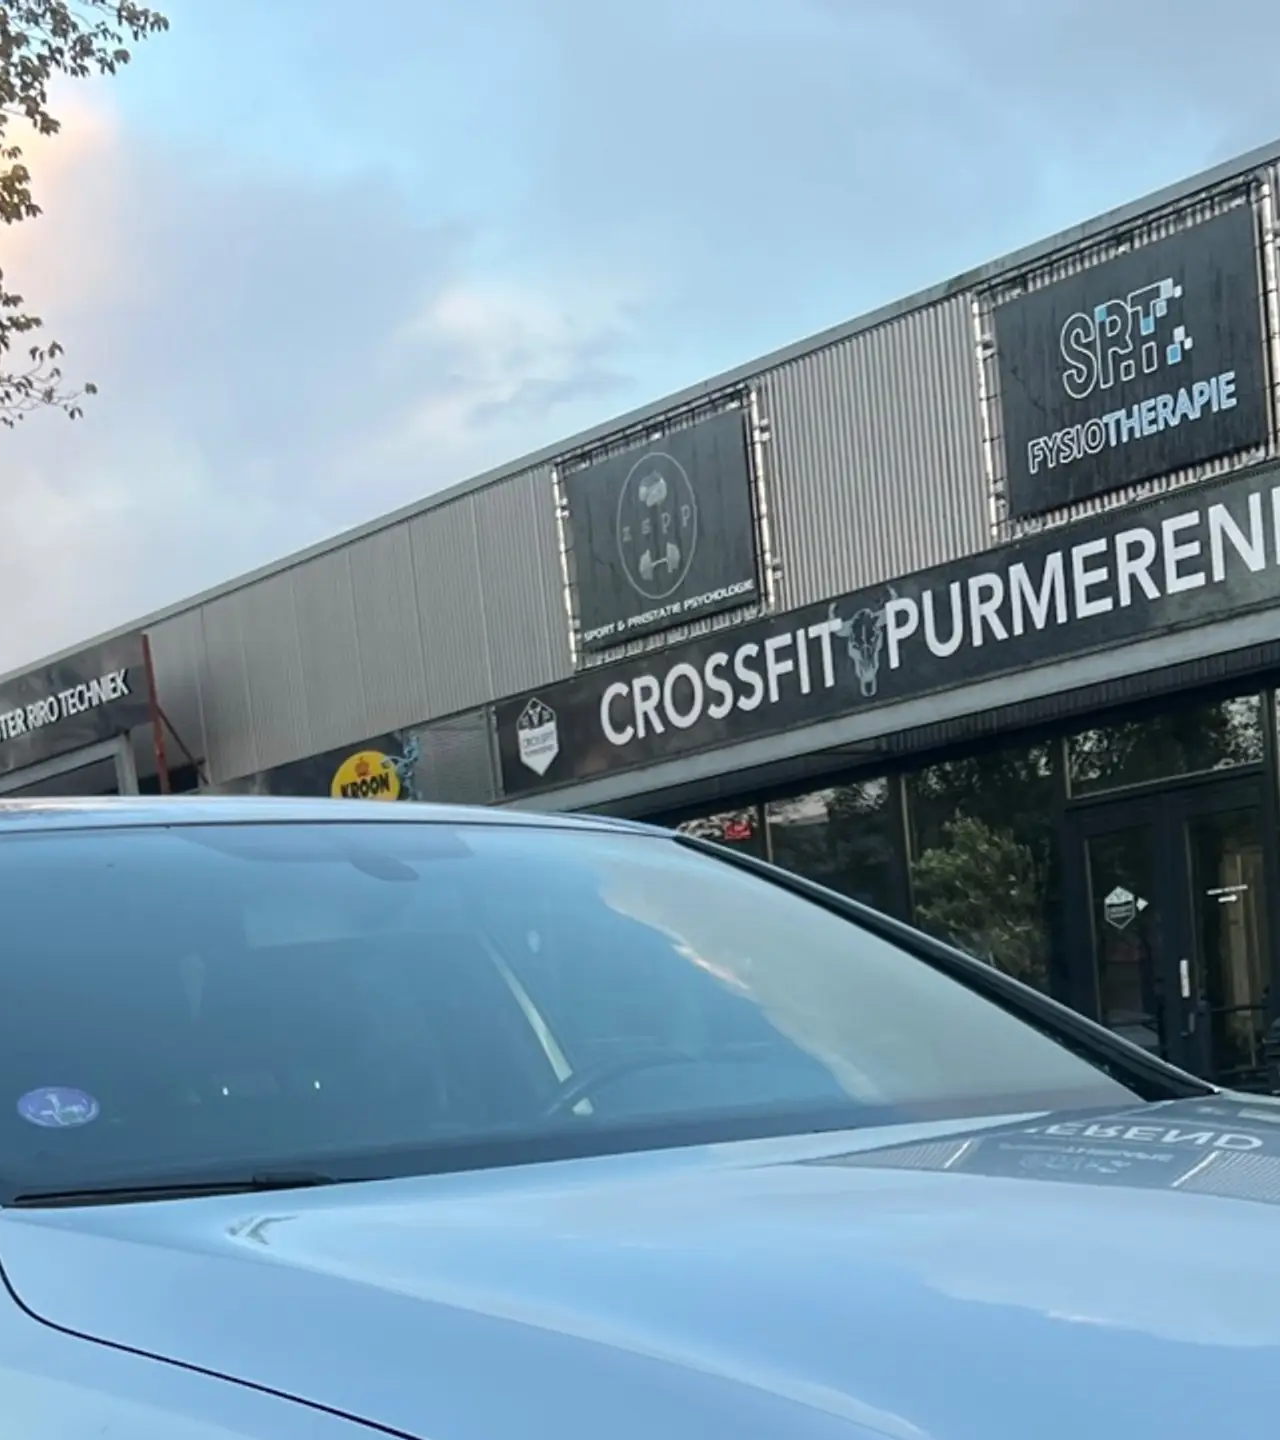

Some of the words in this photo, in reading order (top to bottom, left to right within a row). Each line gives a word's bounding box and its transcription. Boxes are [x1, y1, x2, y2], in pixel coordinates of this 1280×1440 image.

[1028, 371, 1237, 474] FYSIOTHERAPIE
[584, 621, 616, 642] SPORT
[684, 579, 755, 611] PSYCHOLOGIE
[26, 696, 59, 729] RIRO
[59, 668, 131, 717] TECHNIEK
[599, 617, 842, 746] CROSSFIT
[341, 772, 390, 798] KROON
